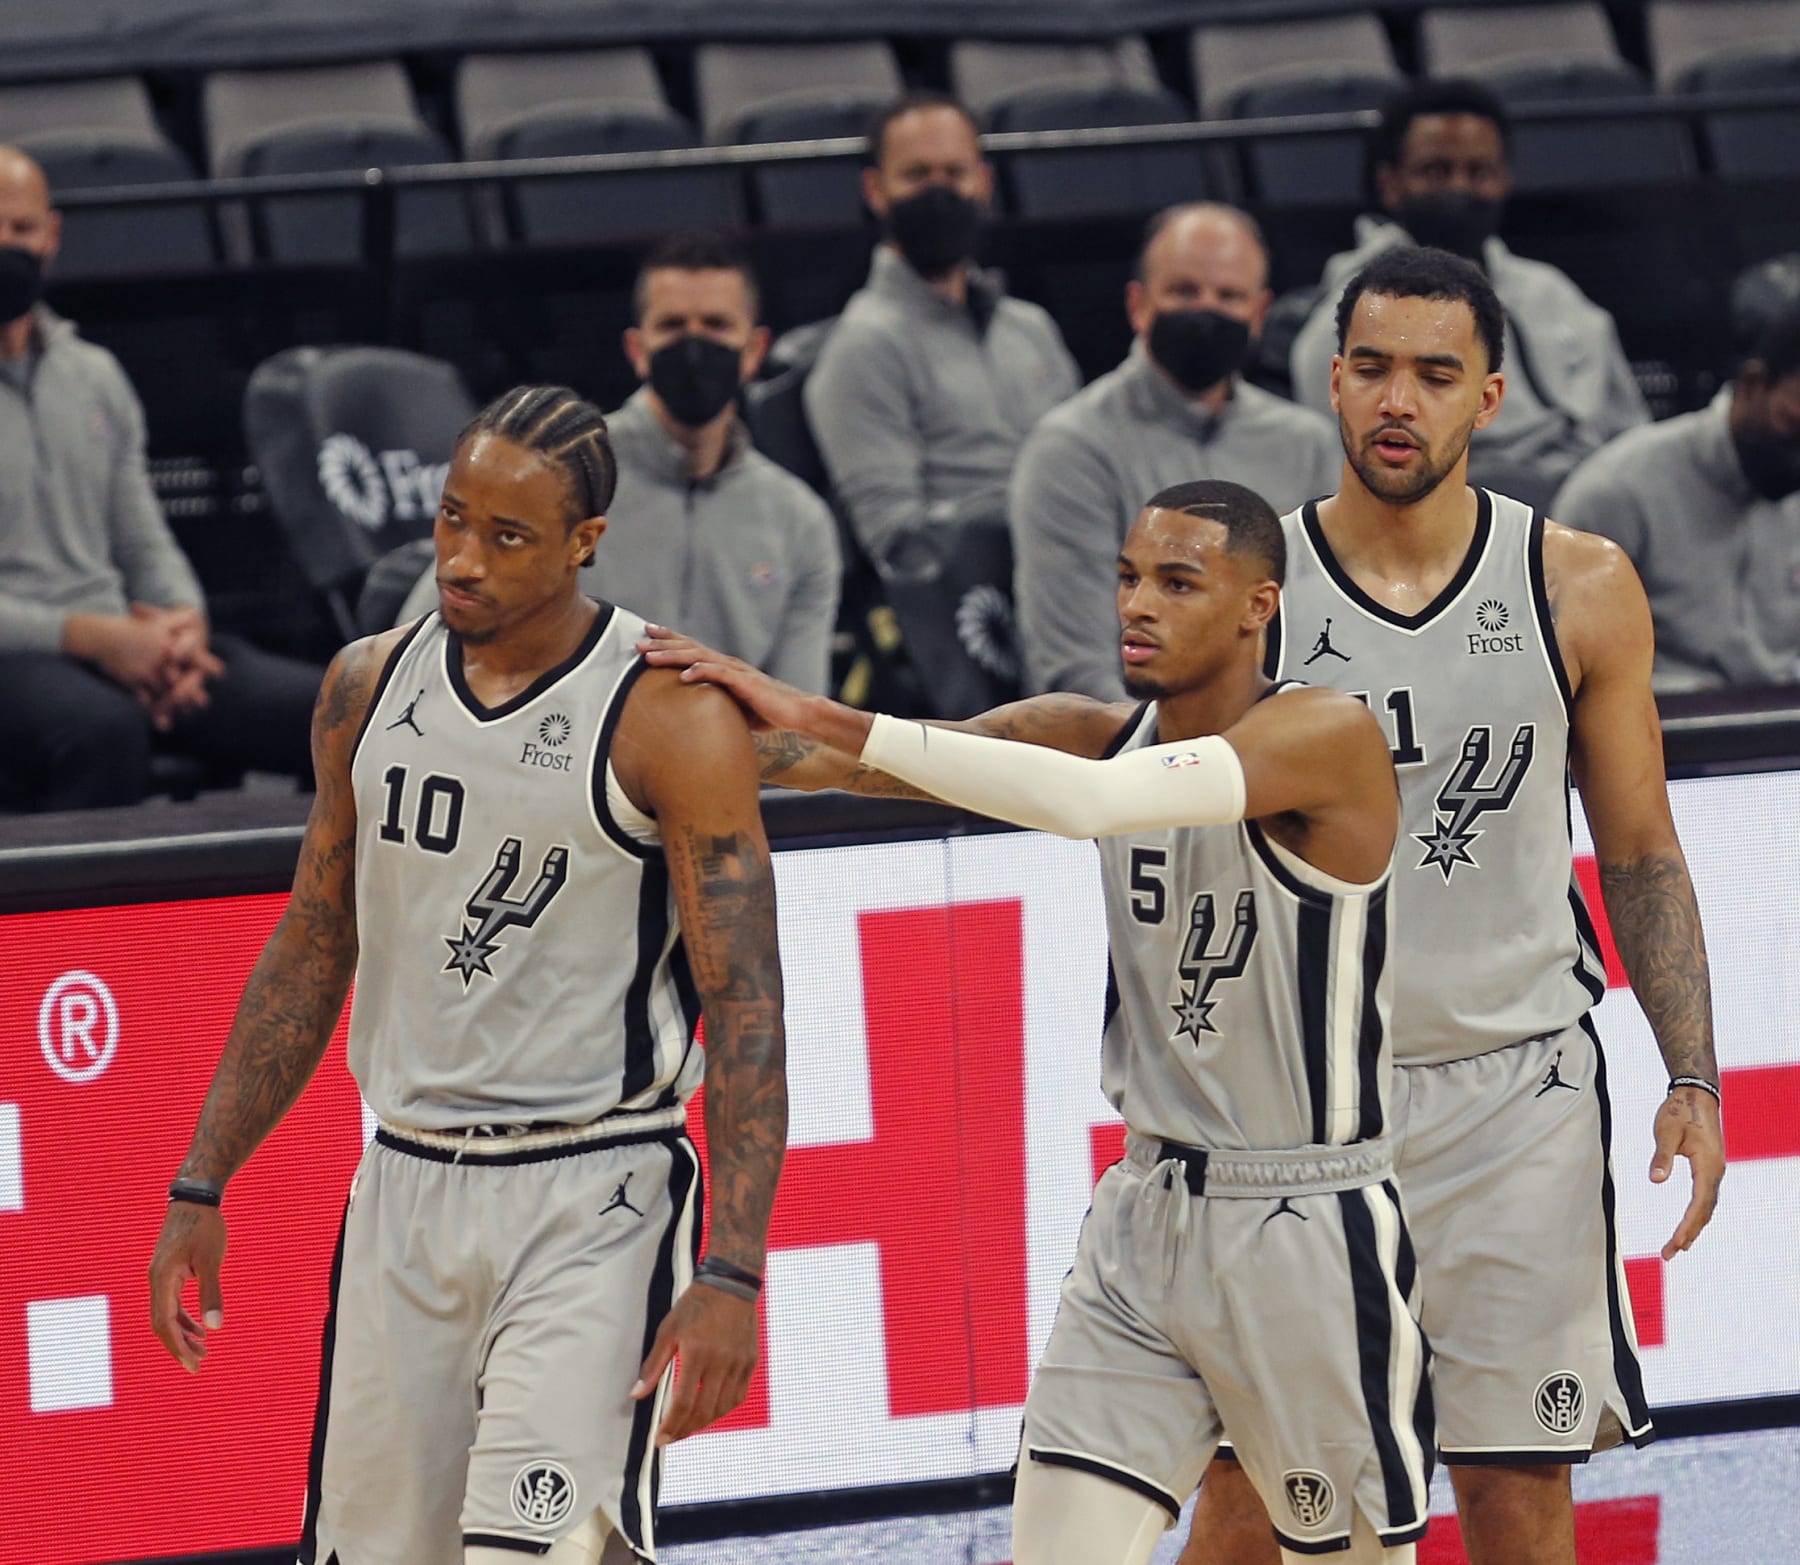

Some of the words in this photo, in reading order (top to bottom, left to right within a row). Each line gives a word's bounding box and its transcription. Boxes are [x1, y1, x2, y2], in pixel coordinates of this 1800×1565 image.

[1467, 633, 1523, 655] Frost
[519, 742, 573, 772] Frost
[1350, 687, 1428, 768] 1
[378, 762, 467, 857] 10
[1128, 844, 1168, 925] 5
